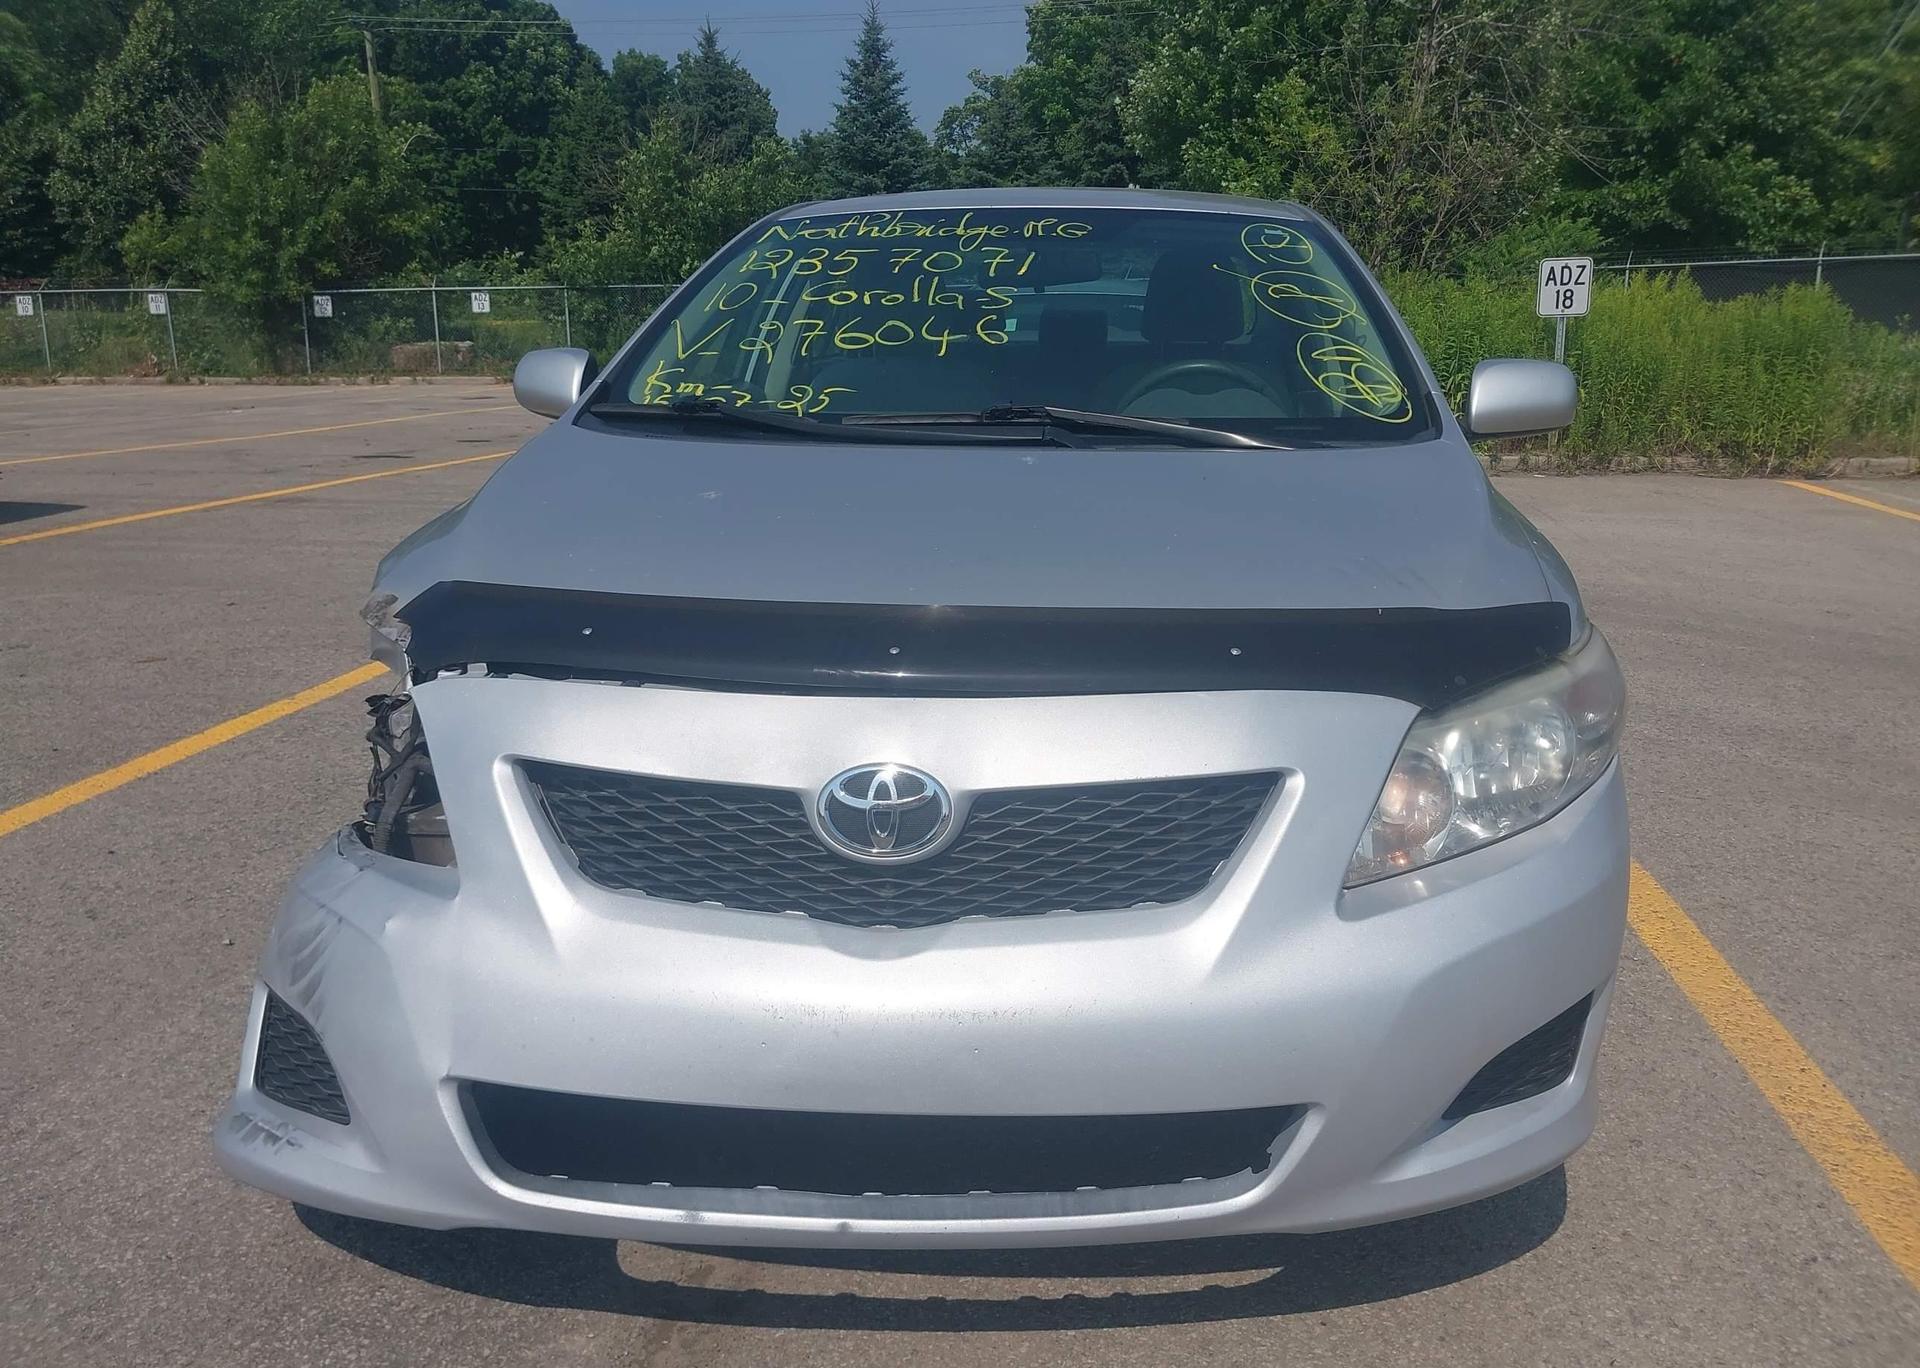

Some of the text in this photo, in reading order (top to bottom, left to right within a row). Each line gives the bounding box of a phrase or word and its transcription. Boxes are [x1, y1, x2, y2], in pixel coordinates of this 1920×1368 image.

[1545, 264, 1587, 287] ADZ
[150, 295, 164, 305] ADZ
[473, 293, 487, 302] ADZ
[1555, 288, 1574, 310] 18
[477, 302, 485, 311] 13
